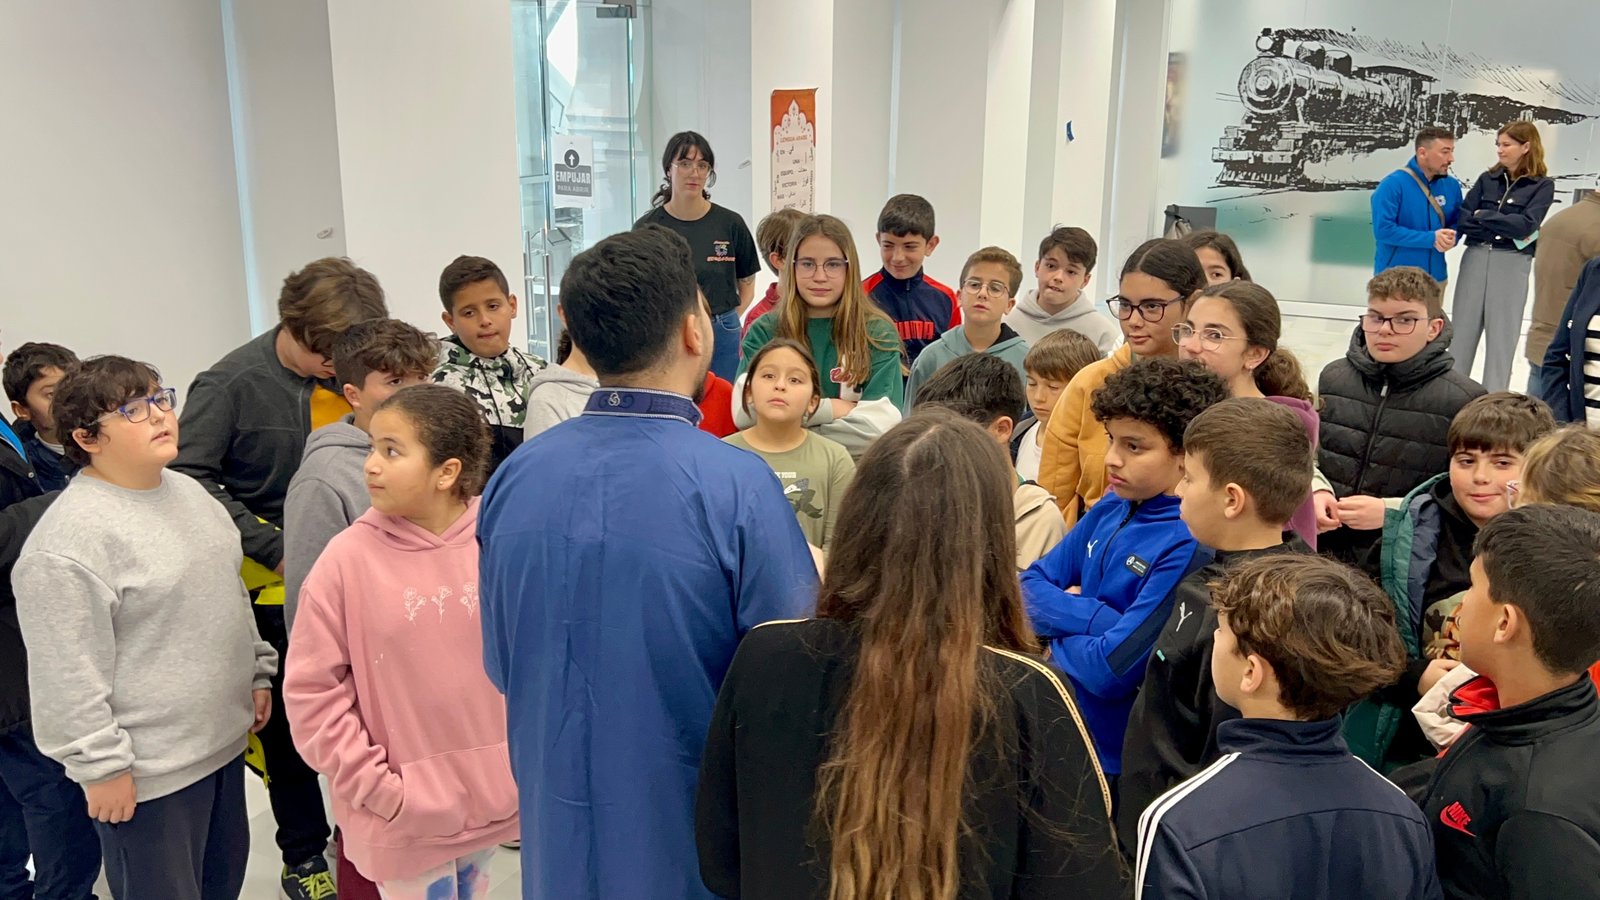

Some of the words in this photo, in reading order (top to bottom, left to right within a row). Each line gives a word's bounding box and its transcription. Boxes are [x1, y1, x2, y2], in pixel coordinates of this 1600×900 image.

[555, 170, 591, 184] EMPUJAR
[557, 184, 571, 192] PARA
[895, 320, 934, 340] UMA
